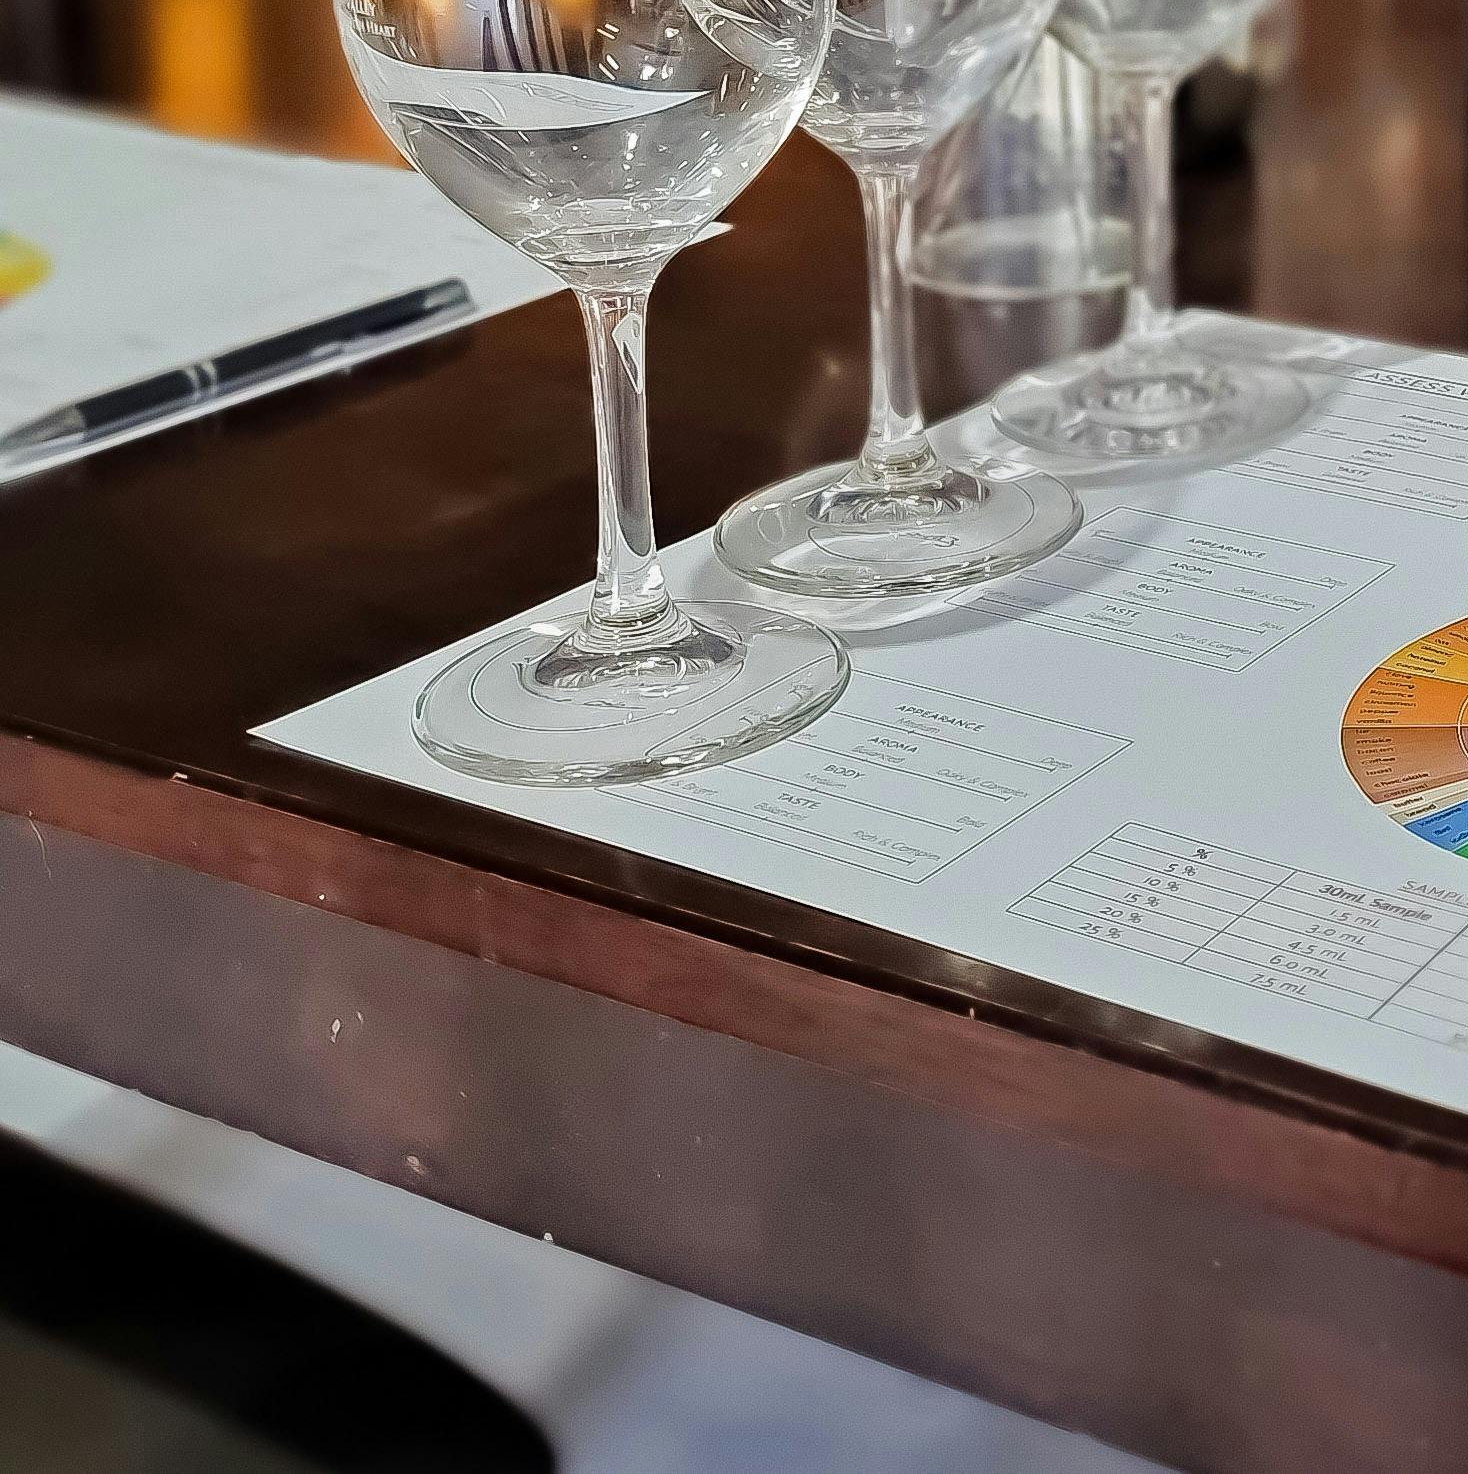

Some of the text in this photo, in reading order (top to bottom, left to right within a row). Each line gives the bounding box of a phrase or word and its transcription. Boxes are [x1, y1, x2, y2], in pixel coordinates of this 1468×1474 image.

[1363, 372, 1454, 393] ASSESS
[1186, 536, 1267, 560] APPEARANCE
[1169, 561, 1213, 576] AROMA
[1101, 603, 1143, 619] TASTE
[895, 704, 985, 733] APPEARANCE
[868, 736, 919, 754] AROMA
[823, 763, 866, 780] BODY
[777, 792, 822, 811] TASTE
[1163, 863, 1179, 874] 5
[1143, 876, 1162, 888] 10
[1122, 891, 1143, 904] 15
[1317, 883, 1434, 923] 30mL Sample
[1098, 906, 1125, 919] 20
[1077, 921, 1102, 936] 25
[1355, 913, 1382, 930] mL
[1337, 930, 1367, 947] mL
[1319, 947, 1349, 963] mL
[1301, 963, 1330, 980] mL
[1280, 979, 1311, 997] mL
